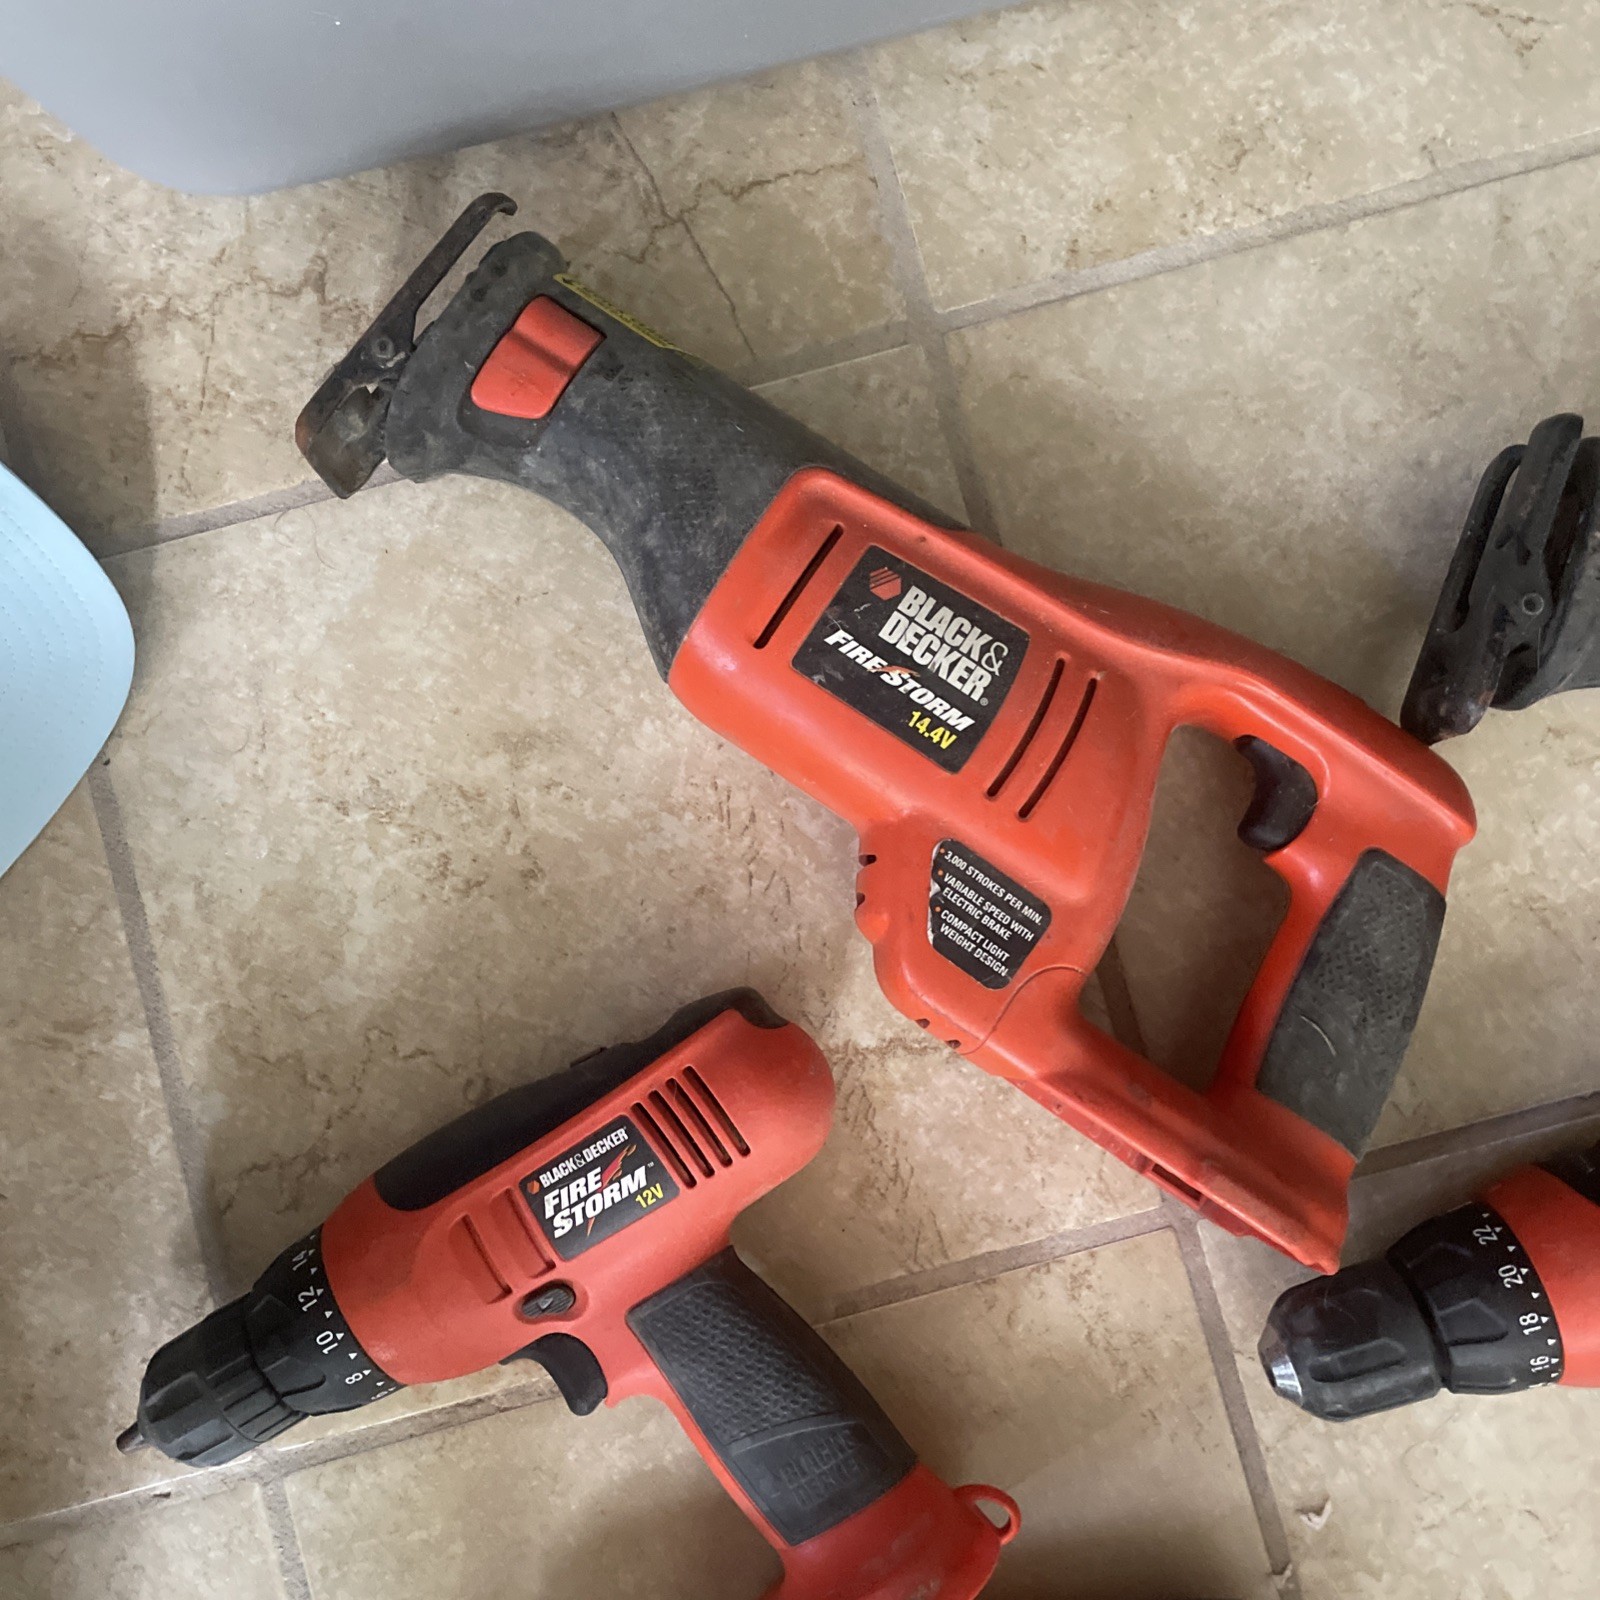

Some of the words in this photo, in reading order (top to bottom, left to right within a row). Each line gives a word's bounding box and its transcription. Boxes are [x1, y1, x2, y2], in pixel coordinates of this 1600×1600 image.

[908, 711, 957, 750] 14.4V
[944, 850, 967, 871] 3,000
[966, 865, 1005, 898] STROKES
[1005, 892, 1023, 911] PER
[1021, 905, 1043, 926] MIN.
[942, 887, 984, 920] ELECTRIC
[981, 914, 1013, 941] BRAKE
[943, 872, 983, 907] VARIABLE
[982, 901, 1010, 924] SPEED
[1010, 920, 1035, 942] WITH
[940, 909, 985, 944] COMPACT
[982, 938, 1010, 962] LIGHT
[940, 923, 976, 953] WEIGHT
[543, 1166, 604, 1220] FIRE
[635, 1182, 664, 1208] 12V
[1472, 1224, 1498, 1245] 22
[1497, 1264, 1524, 1289] 20
[297, 1285, 318, 1312] 12
[1518, 1312, 1542, 1336] 18
[315, 1330, 339, 1355] 10
[1529, 1355, 1550, 1373] 16
[344, 1371, 364, 1386] 8
